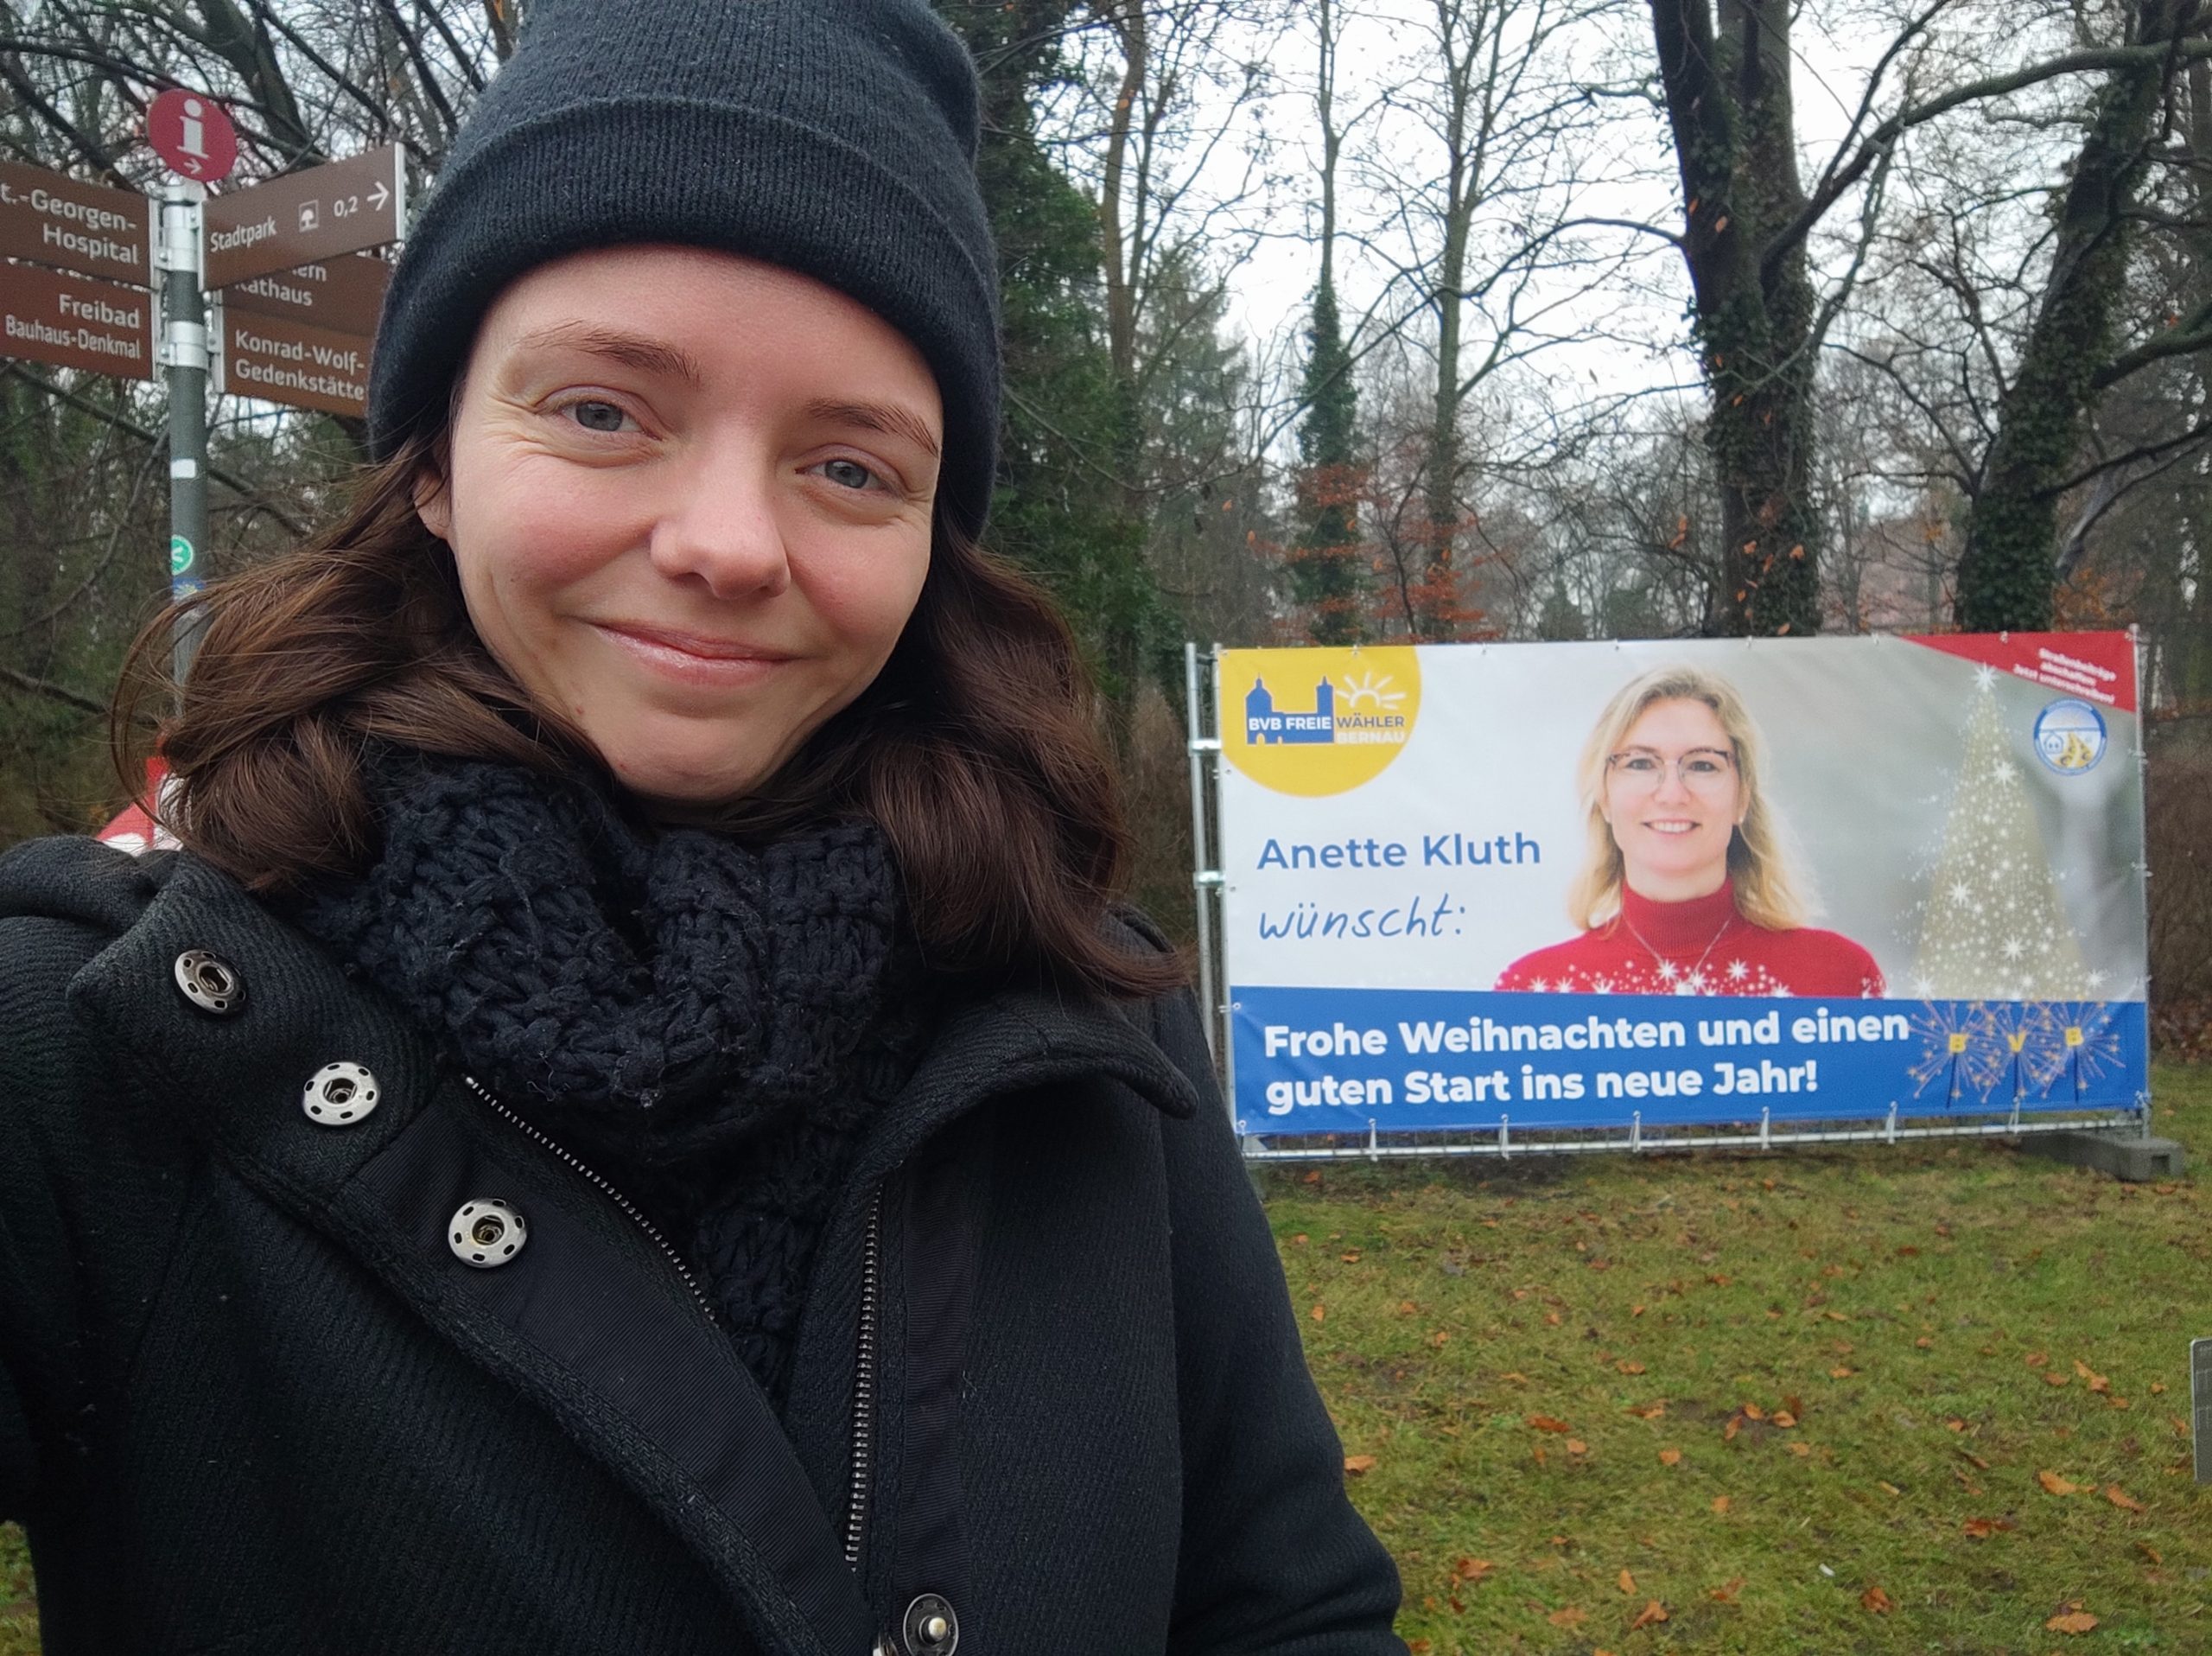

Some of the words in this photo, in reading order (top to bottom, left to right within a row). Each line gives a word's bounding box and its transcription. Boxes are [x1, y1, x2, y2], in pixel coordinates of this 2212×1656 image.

[0, 182, 137, 232] t.-Georgen-
[210, 215, 277, 252] Stadtpark
[334, 195, 358, 218] 0,2
[43, 222, 139, 265] Hospital
[59, 293, 140, 329] Freibad
[5, 314, 141, 360] Bauhaus-Denkmal
[235, 328, 365, 376] Konrad-Wolf-
[235, 358, 365, 401] Gedenkstätte
[1249, 717, 1281, 731] BVB
[1286, 716, 1332, 730] FREIE
[1336, 712, 1405, 729] WÄHLER
[1336, 730, 1406, 744] BERNAU
[1256, 838, 1408, 870] Anette
[1422, 831, 1541, 866] Kluth
[1258, 892, 1466, 940] wünscht:
[1264, 1022, 1388, 1058] Frohe
[1398, 1015, 1686, 1054] Weihnachten
[1698, 1010, 1780, 1046] und
[1791, 1007, 1910, 1044] einen
[1265, 1075, 1393, 1116] guten
[1404, 1070, 1512, 1105] Start
[1521, 1064, 1586, 1100] ins
[1596, 1069, 1703, 1099] neue
[1713, 1060, 1818, 1095] Jahr!
